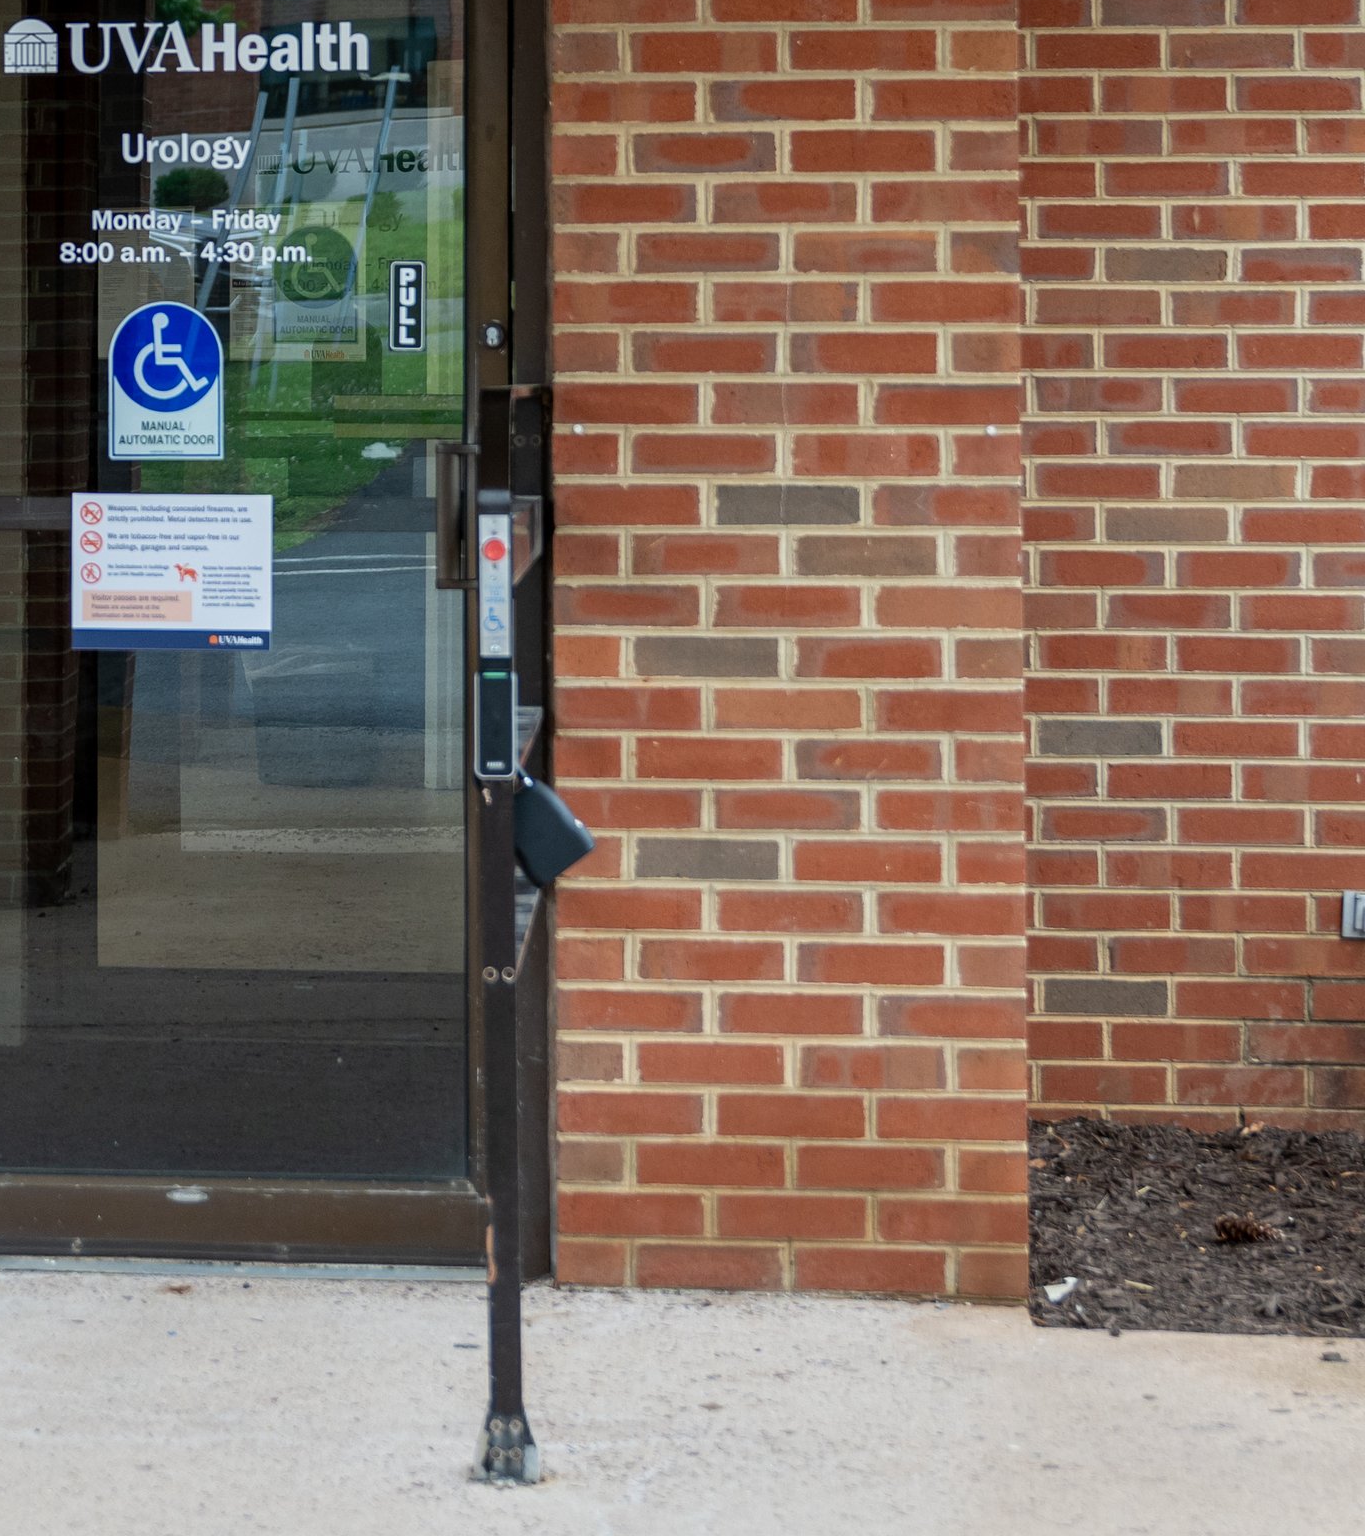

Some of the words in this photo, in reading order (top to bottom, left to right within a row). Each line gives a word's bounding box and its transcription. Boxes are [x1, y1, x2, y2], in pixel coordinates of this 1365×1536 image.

[121, 133, 251, 170] Urology
[91, 209, 183, 235] Monday
[211, 209, 282, 235] Friday
[59, 241, 115, 263] 8:00
[120, 245, 172, 263] a.m.
[200, 241, 255, 263] 4:30
[261, 244, 313, 267] p.m.
[398, 267, 417, 346] PULL
[330, 325, 354, 335] DOOR
[141, 420, 186, 431] MANUAL
[118, 434, 181, 445] AUTOMATIC
[183, 434, 215, 445] DOOR
[141, 505, 171, 513] including
